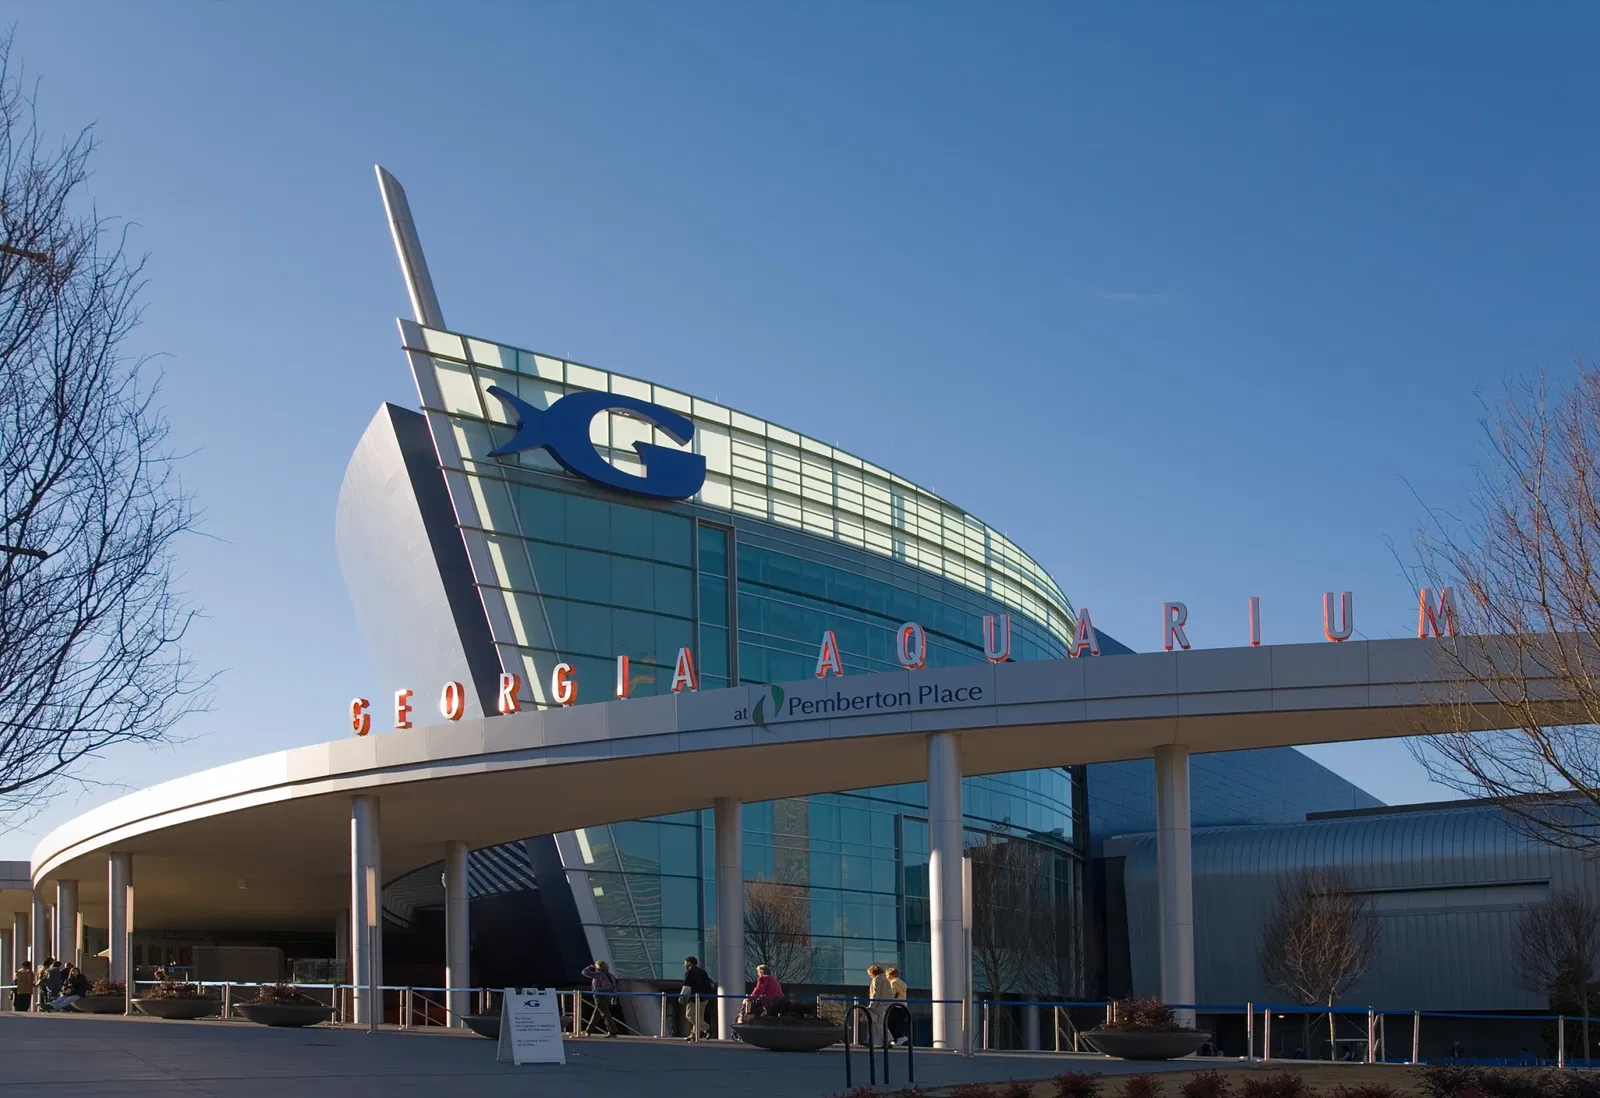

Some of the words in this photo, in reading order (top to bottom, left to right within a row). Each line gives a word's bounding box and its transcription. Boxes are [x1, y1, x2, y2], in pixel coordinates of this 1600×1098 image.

[349, 647, 700, 736] GEORGIA
[815, 586, 1460, 679] AQUARIUM
[733, 707, 748, 721] at
[789, 691, 911, 716] Pemberton
[918, 684, 983, 705] Place
